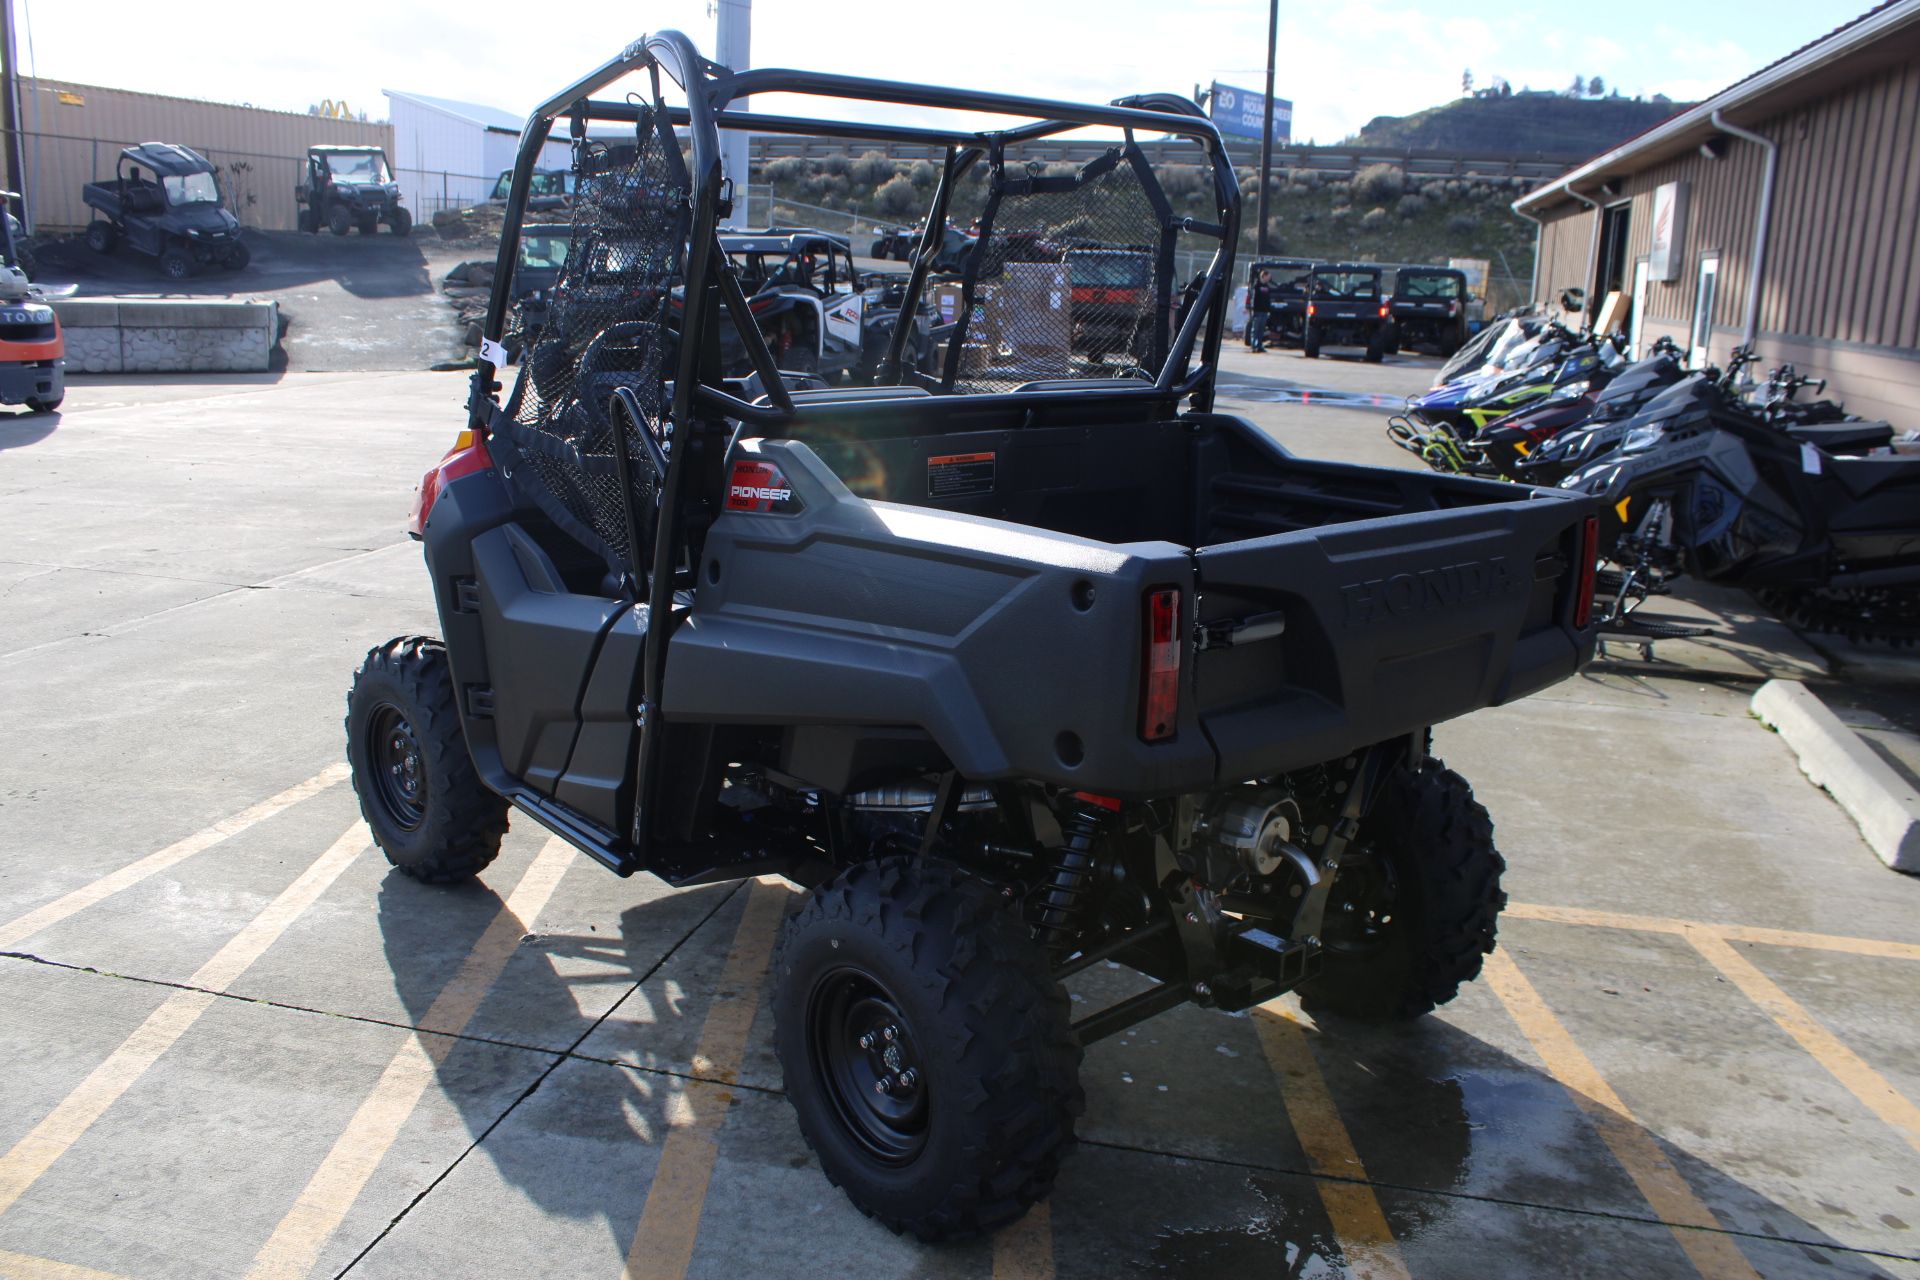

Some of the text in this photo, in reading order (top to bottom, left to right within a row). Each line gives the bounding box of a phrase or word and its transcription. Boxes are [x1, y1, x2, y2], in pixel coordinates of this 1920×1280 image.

[481, 342, 490, 357] 2
[731, 485, 792, 501] PIONEER
[1340, 556, 1513, 626] HONDA
